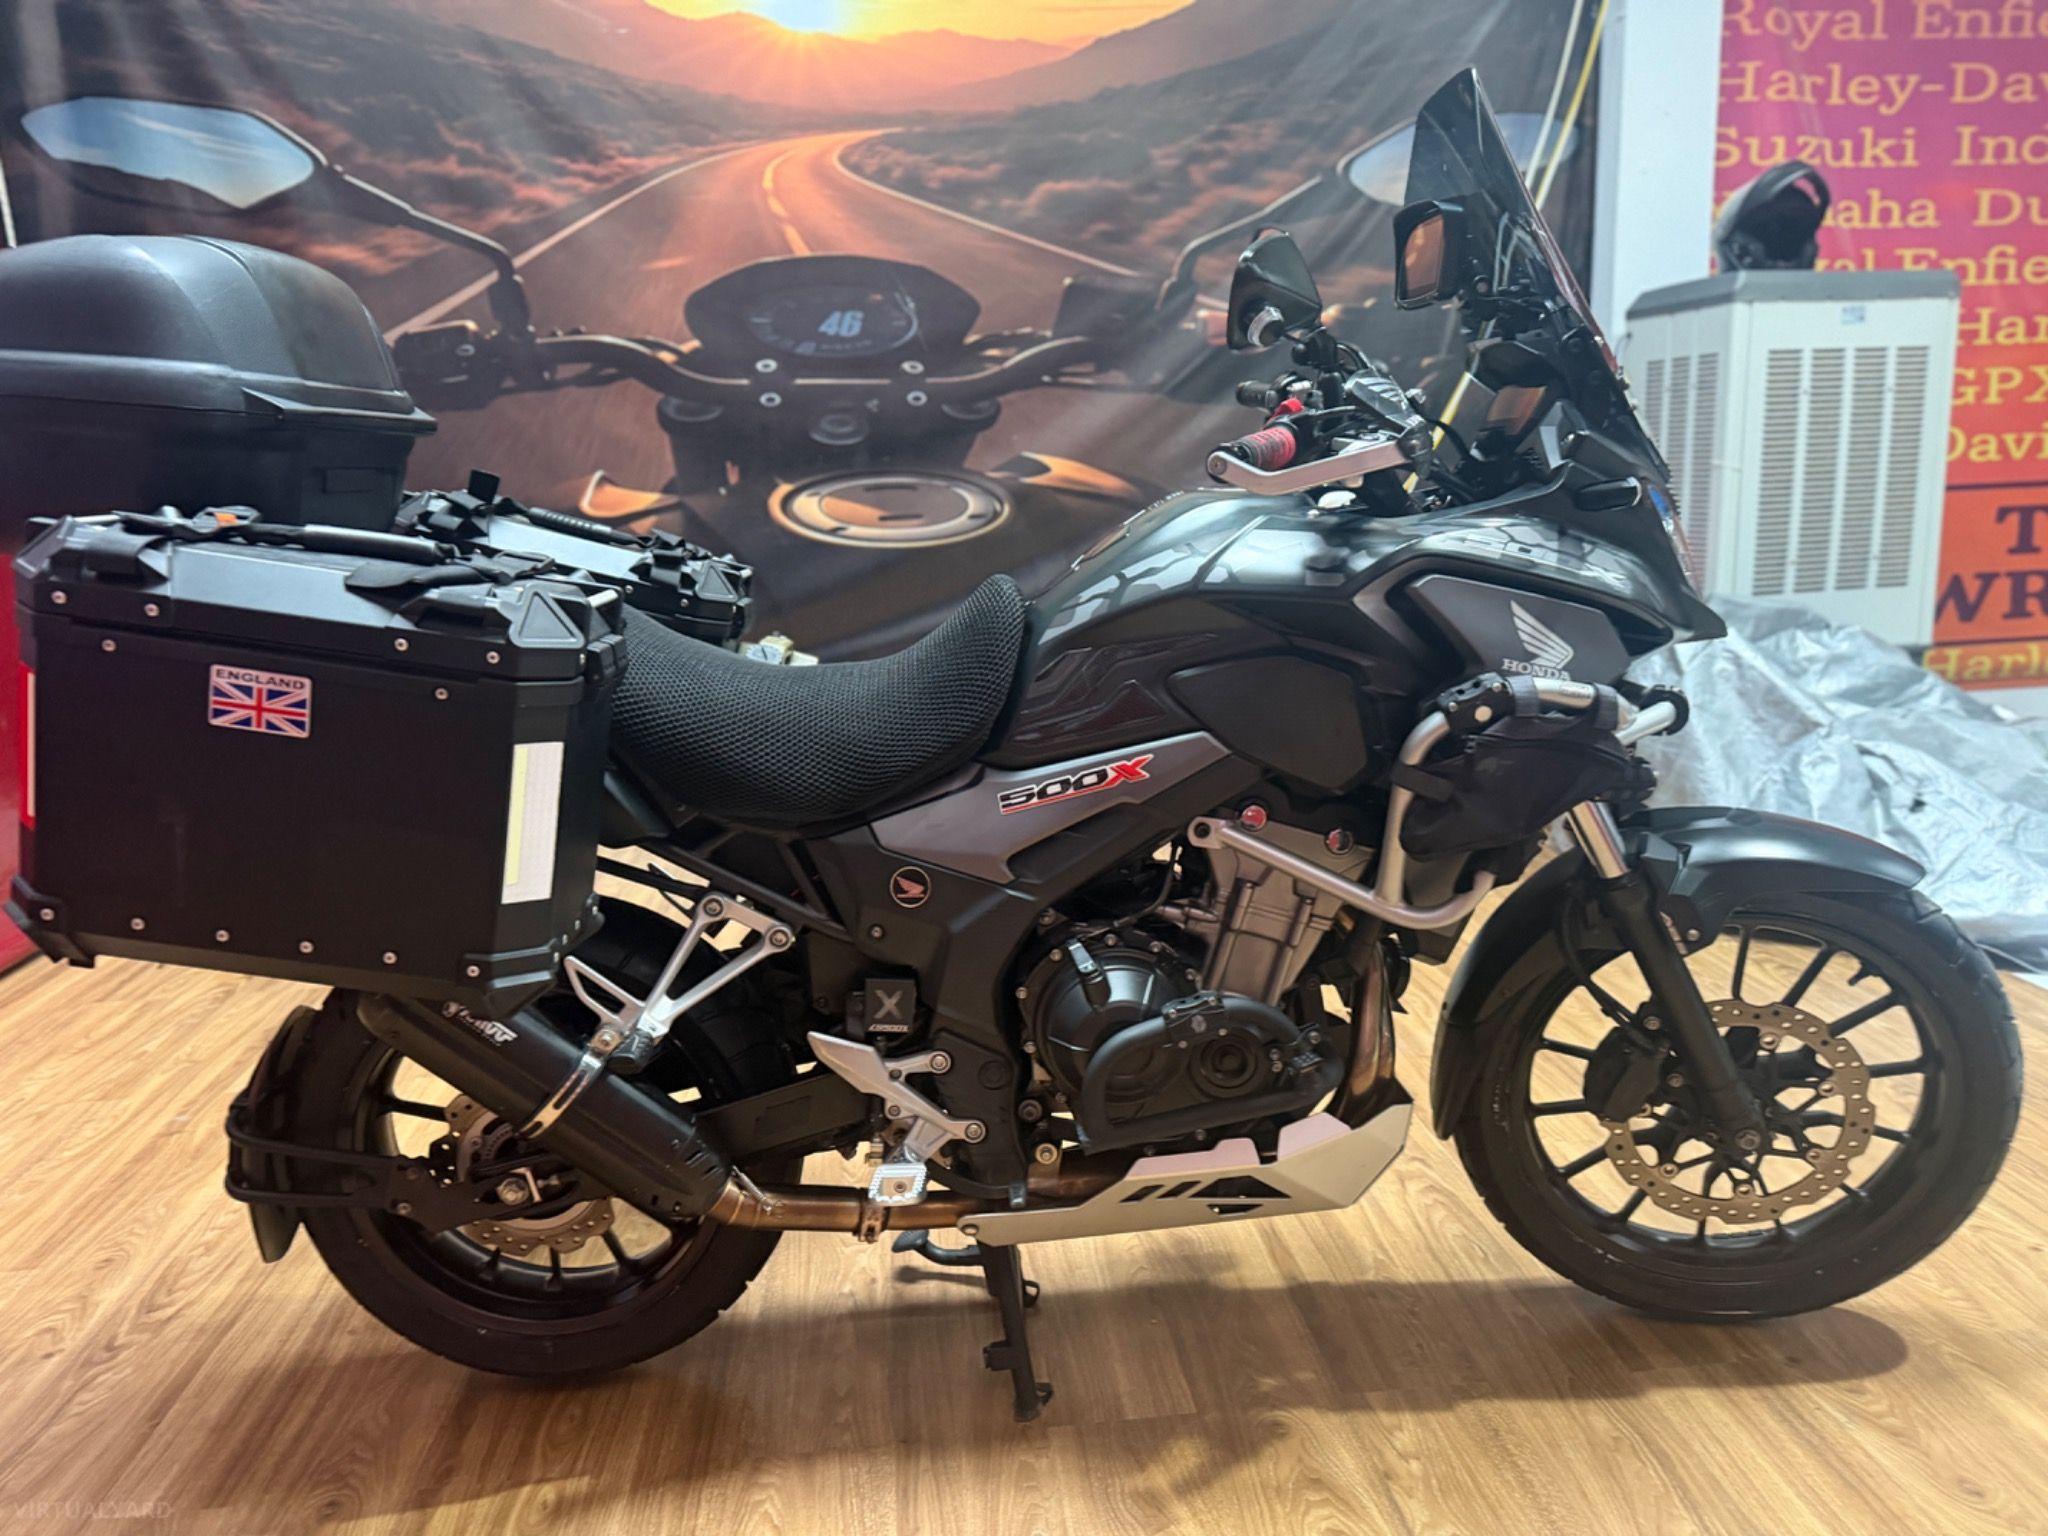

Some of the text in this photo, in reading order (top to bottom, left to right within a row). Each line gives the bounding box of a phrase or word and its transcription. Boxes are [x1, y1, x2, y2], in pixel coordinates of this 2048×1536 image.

[1719, 60, 2048, 116] Harley-Da
[1715, 126, 1920, 168] Suzuki
[818, 310, 864, 337] 46
[215, 668, 306, 690] ENGLAND
[1501, 657, 1571, 681] HONDA
[1922, 643, 2048, 682] Harl
[998, 754, 1154, 815] 500X
